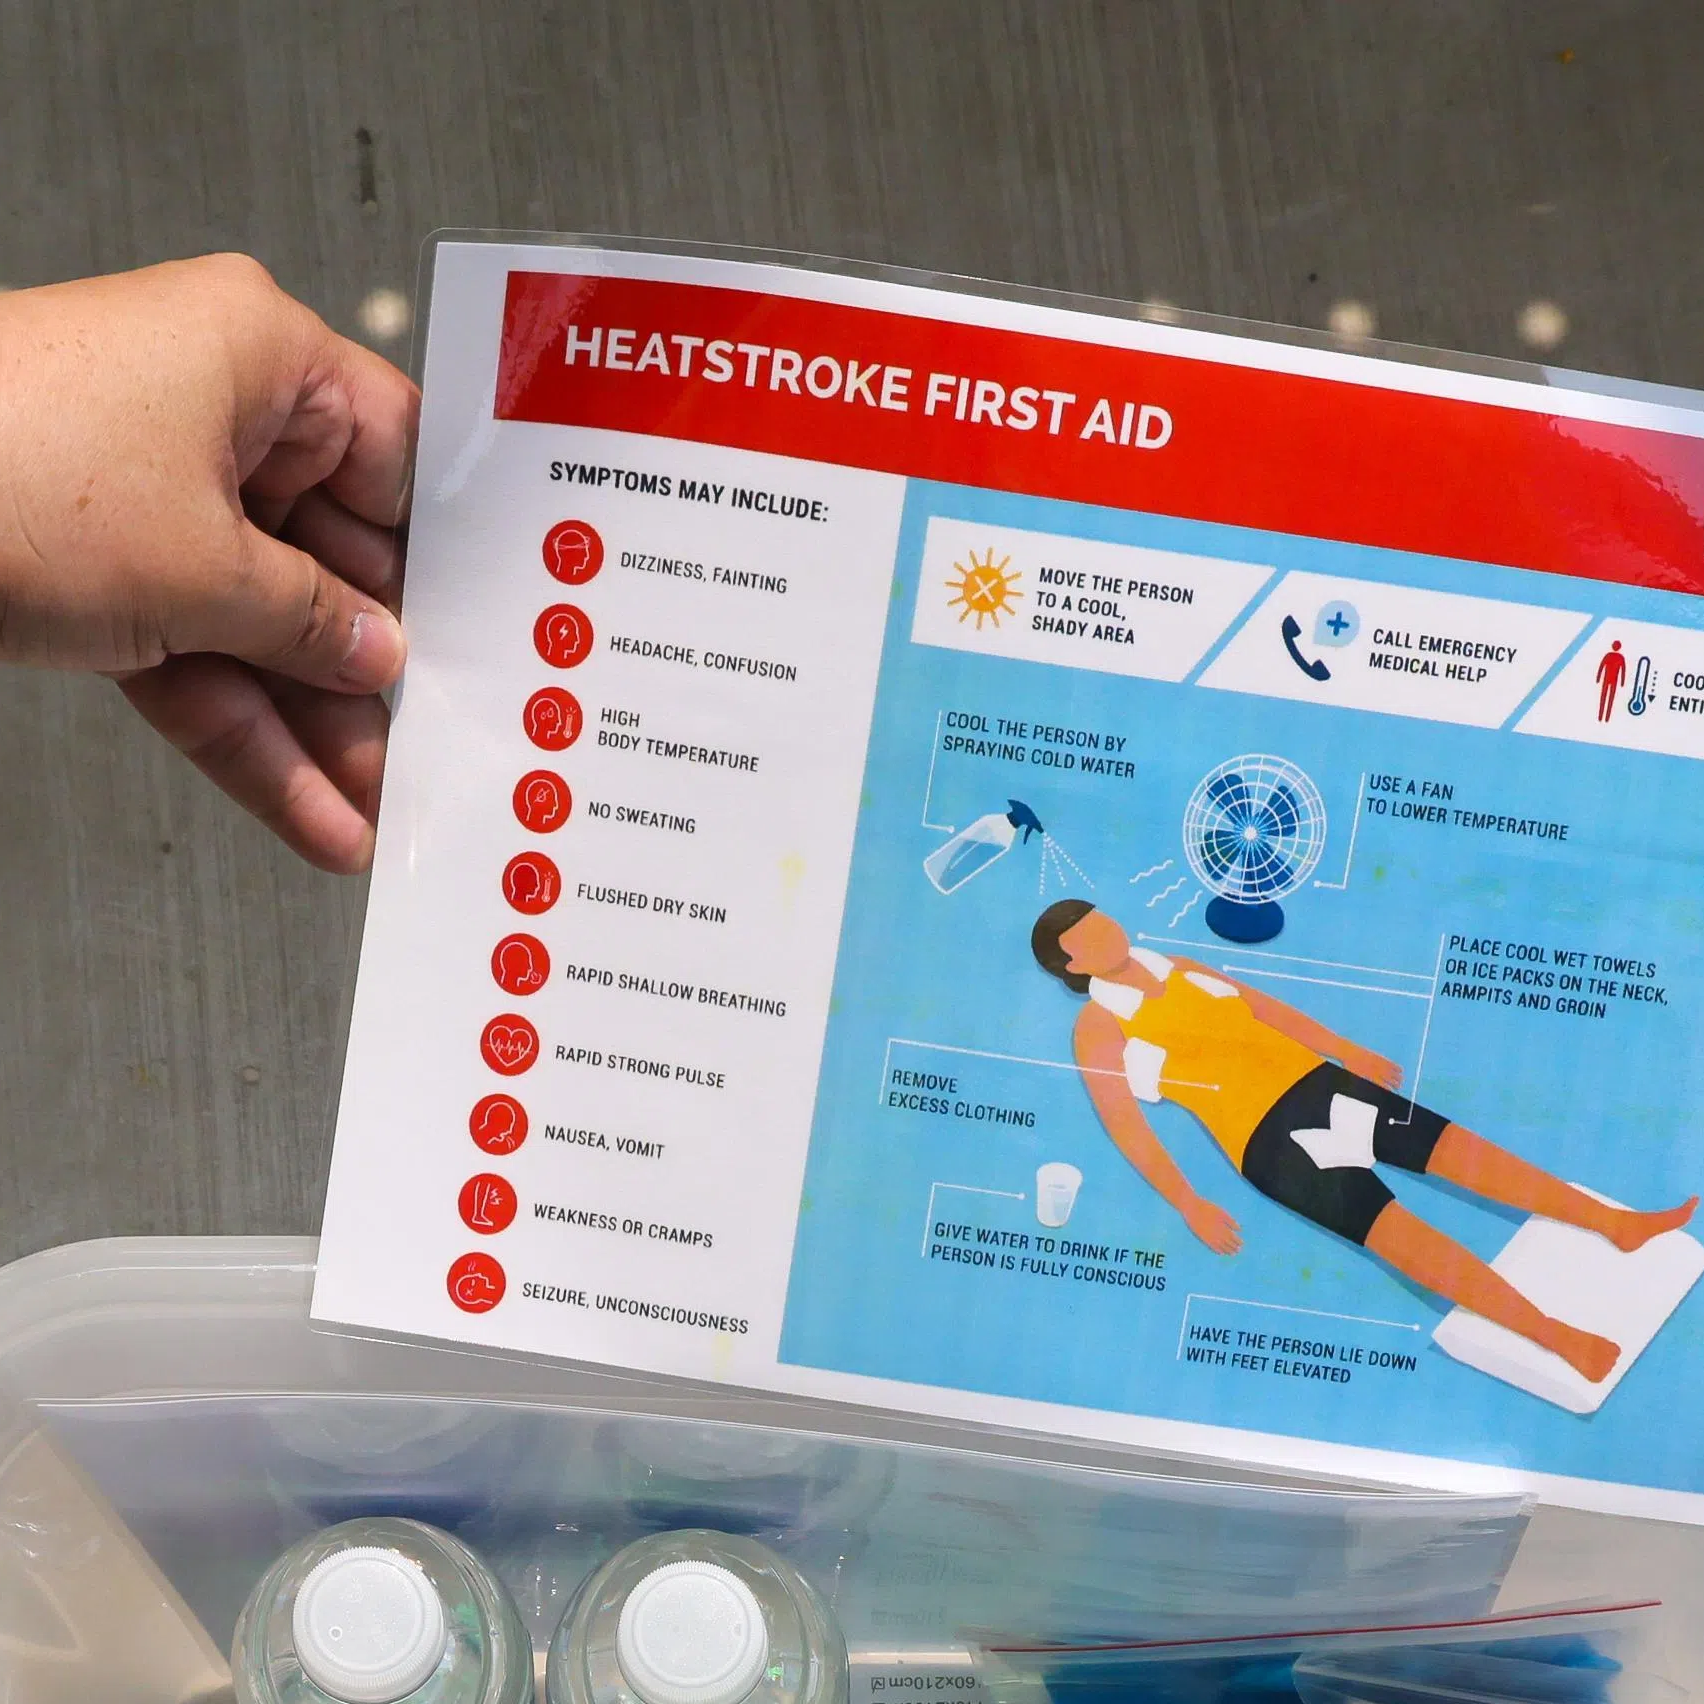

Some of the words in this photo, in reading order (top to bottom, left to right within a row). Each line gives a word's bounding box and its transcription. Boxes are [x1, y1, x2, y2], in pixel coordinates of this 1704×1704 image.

[565, 326, 912, 412] HEATSTROKE
[924, 373, 1076, 436] FIRST
[1081, 398, 1174, 450] AID
[550, 462, 671, 496] SYMPTOMS
[679, 480, 724, 505] MAY
[732, 488, 829, 522] INCLUDE:
[621, 552, 706, 581] DIZZINESS,
[713, 568, 787, 593] FAINTING
[1040, 568, 1086, 589] MOVE
[1092, 575, 1122, 593] THE
[1128, 581, 1194, 604] PERSON
[1036, 592, 1056, 607] TO
[1062, 595, 1073, 610] A
[1079, 598, 1126, 620] COOL,
[1032, 616, 1086, 638] SHADY
[1092, 625, 1134, 644] AREA
[1373, 629, 1412, 648] CALL
[1419, 636, 1517, 663] EMERGENCY
[610, 636, 698, 667] HEADACHE,
[704, 652, 796, 681] CONFUSION
[1370, 653, 1439, 676] MEDICAL
[1446, 664, 1487, 683] HELP
[601, 708, 640, 728] HIGH
[947, 712, 990, 732] COOL
[997, 720, 1028, 738] THE
[1034, 725, 1099, 749] PERSON
[1105, 736, 1126, 752] BY
[598, 732, 640, 749] BODY
[646, 739, 759, 771] TEMPERATURE
[943, 736, 1025, 762] SPRAYING
[1031, 750, 1074, 769] COLD
[1081, 757, 1134, 778] WATER
[1370, 774, 1401, 793] USE
[1406, 781, 1416, 795] A
[1422, 782, 1454, 800] FAN
[589, 802, 610, 819] NO
[616, 807, 695, 833] SWEATING
[1367, 798, 1386, 815] TO
[1392, 802, 1447, 823] LOWER
[1453, 810, 1569, 840] TEMPERATURE
[578, 884, 647, 909] FLUSHED
[653, 898, 684, 914] DRY
[689, 903, 726, 923] SKIN
[1450, 936, 1501, 956] PLACE
[1506, 944, 1548, 963] COOL
[1554, 950, 1588, 970] WET
[1593, 955, 1656, 978] TOWELS
[567, 965, 613, 986] RAPID
[619, 974, 693, 999] SHALLOW
[698, 988, 786, 1017] BREATHING
[1441, 982, 1512, 1005] ARMPITS
[1518, 993, 1550, 1010] AND
[1556, 998, 1606, 1018] GROIN
[1446, 959, 1466, 975] OR
[1472, 963, 1496, 979] ICE
[1503, 967, 1554, 987] PACKS
[1560, 974, 1582, 991] ON
[1588, 979, 1617, 996] THE
[1623, 984, 1668, 1006] NECK,
[556, 1046, 602, 1066] RAPID
[607, 1055, 669, 1079] STRONG
[676, 1067, 726, 1088] PULSE
[892, 1070, 958, 1093] REMOVE
[889, 1092, 949, 1115] EXCESS
[955, 1102, 1036, 1127] CLOTHING
[545, 1125, 609, 1150] NAUSEA,
[616, 1138, 665, 1159] VOMIT
[534, 1204, 617, 1231] WEAKNESS
[623, 1220, 643, 1235] OR
[648, 1224, 713, 1248] CRAMPS
[934, 1222, 971, 1241] GIVE
[977, 1228, 1029, 1249] WATER
[1035, 1237, 1054, 1253] TO
[1061, 1241, 1110, 1261] DRINK
[1114, 1249, 1129, 1262] IF
[1134, 1251, 1165, 1268] THE
[931, 1245, 995, 1267] PERSON
[1001, 1255, 1015, 1270] IS
[1021, 1258, 1068, 1277] FULLY
[1073, 1266, 1166, 1291] CONSCIOUS
[523, 1283, 589, 1308] SEIZURE,
[596, 1295, 748, 1333] UNCONSCIOUSNESS
[1187, 1347, 1225, 1365] WITH
[1232, 1353, 1269, 1371] FEET
[1274, 1359, 1351, 1383] ELEVATED
[1190, 1325, 1231, 1344] HAVE
[1237, 1331, 1266, 1349] THE
[1271, 1337, 1334, 1359] PERSON
[1340, 1346, 1364, 1363] LIE
[1369, 1350, 1416, 1371] DOWN
[889, 1676, 981, 1689] 60x210cm
